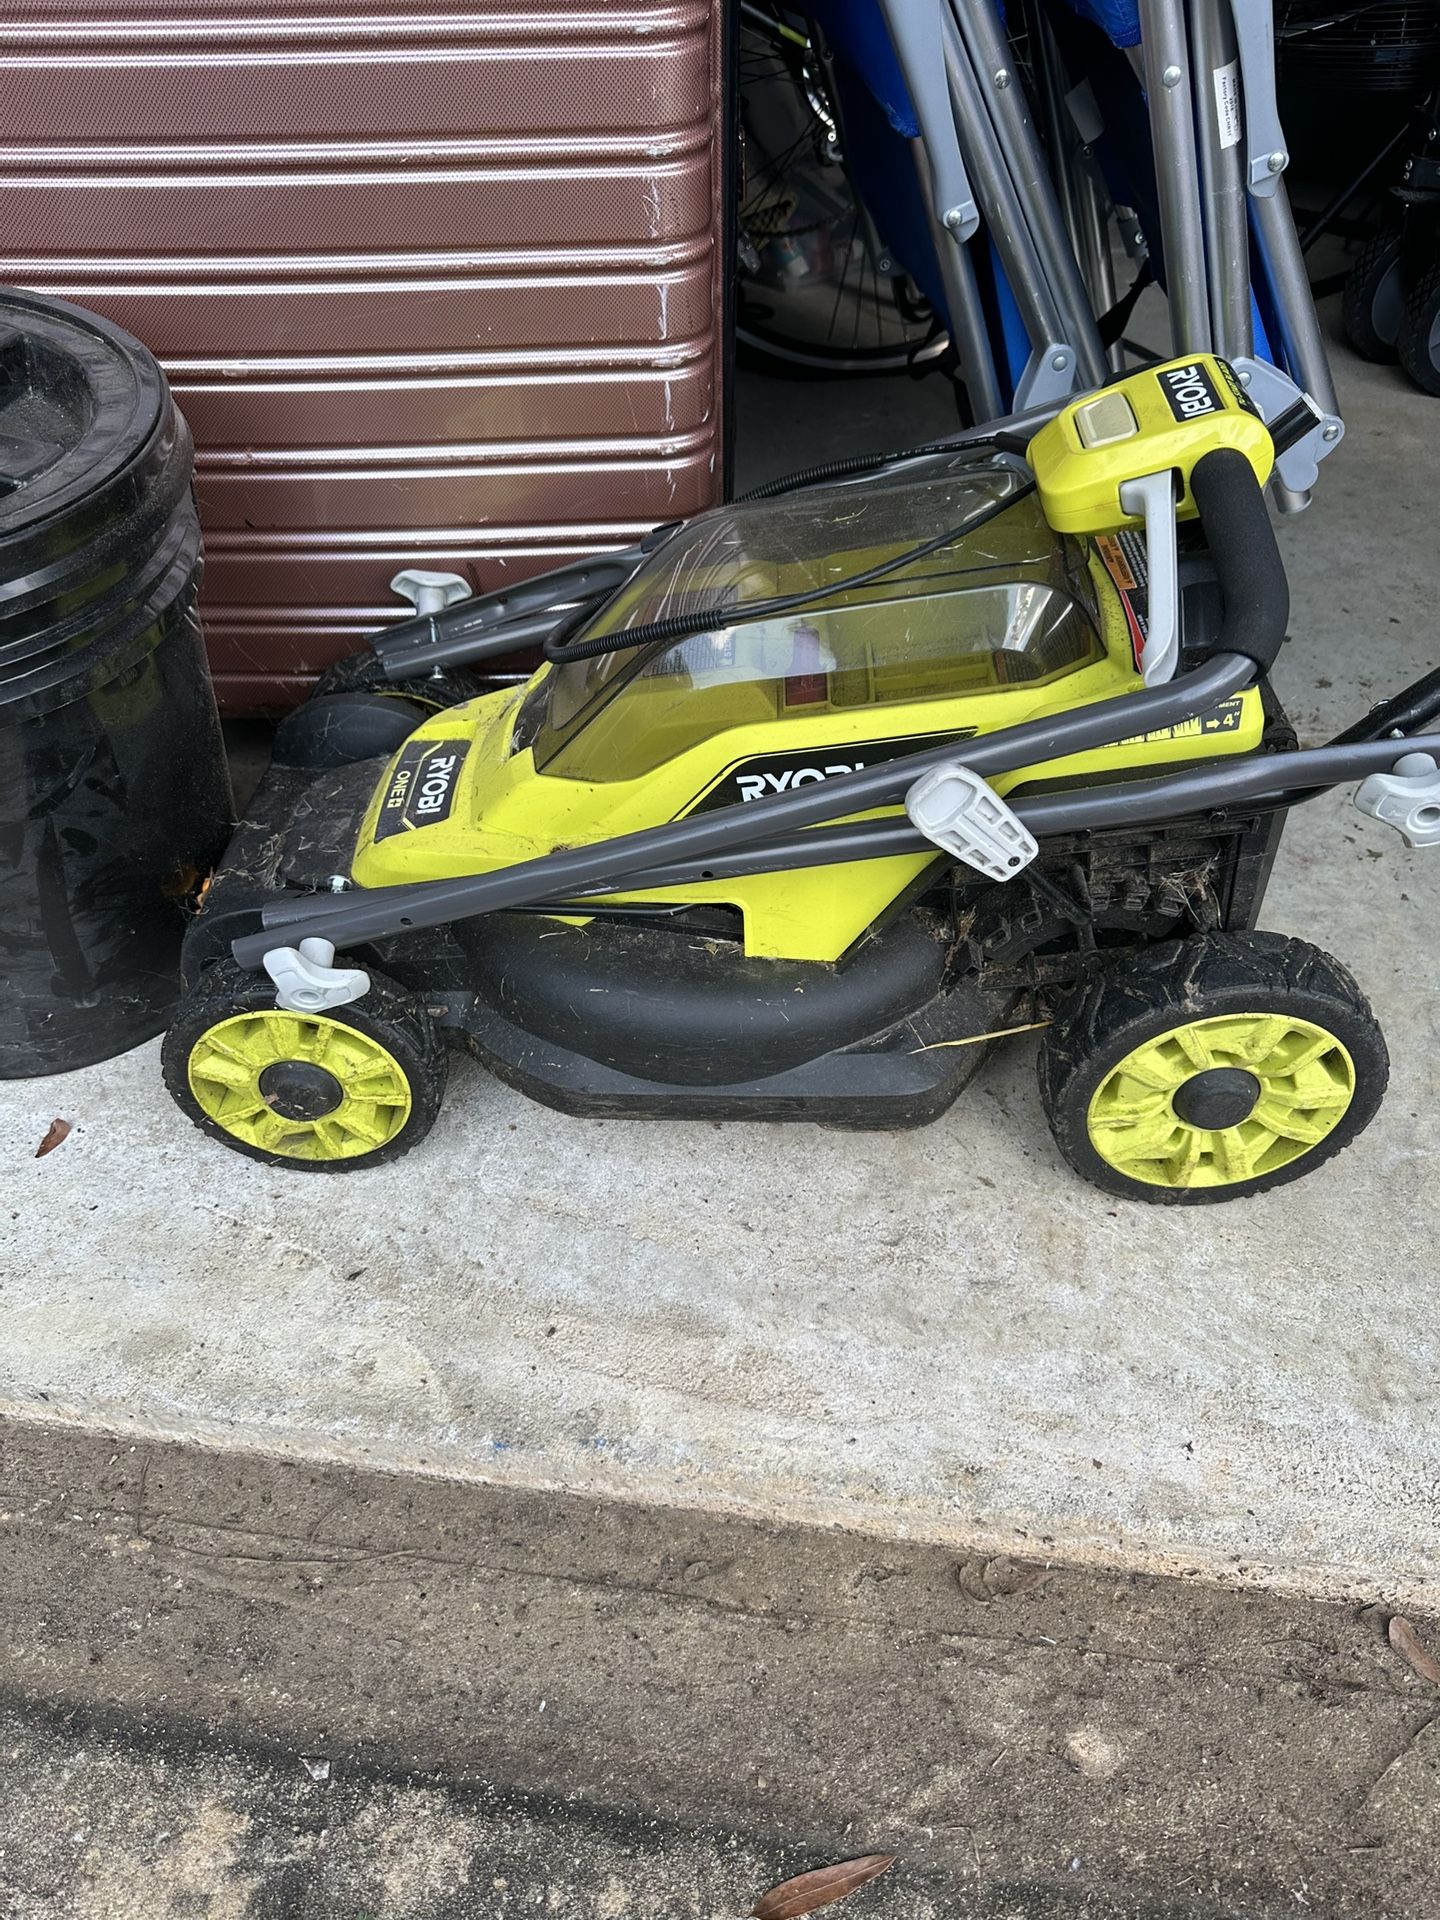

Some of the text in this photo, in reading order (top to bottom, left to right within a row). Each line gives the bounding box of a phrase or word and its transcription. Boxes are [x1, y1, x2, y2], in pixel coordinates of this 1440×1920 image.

[1166, 366, 1215, 418] RYOBI
[1215, 700, 1240, 709] MENT
[1223, 711, 1240, 727] 4"
[416, 755, 457, 814] RYOBI
[736, 762, 865, 801] RYO
